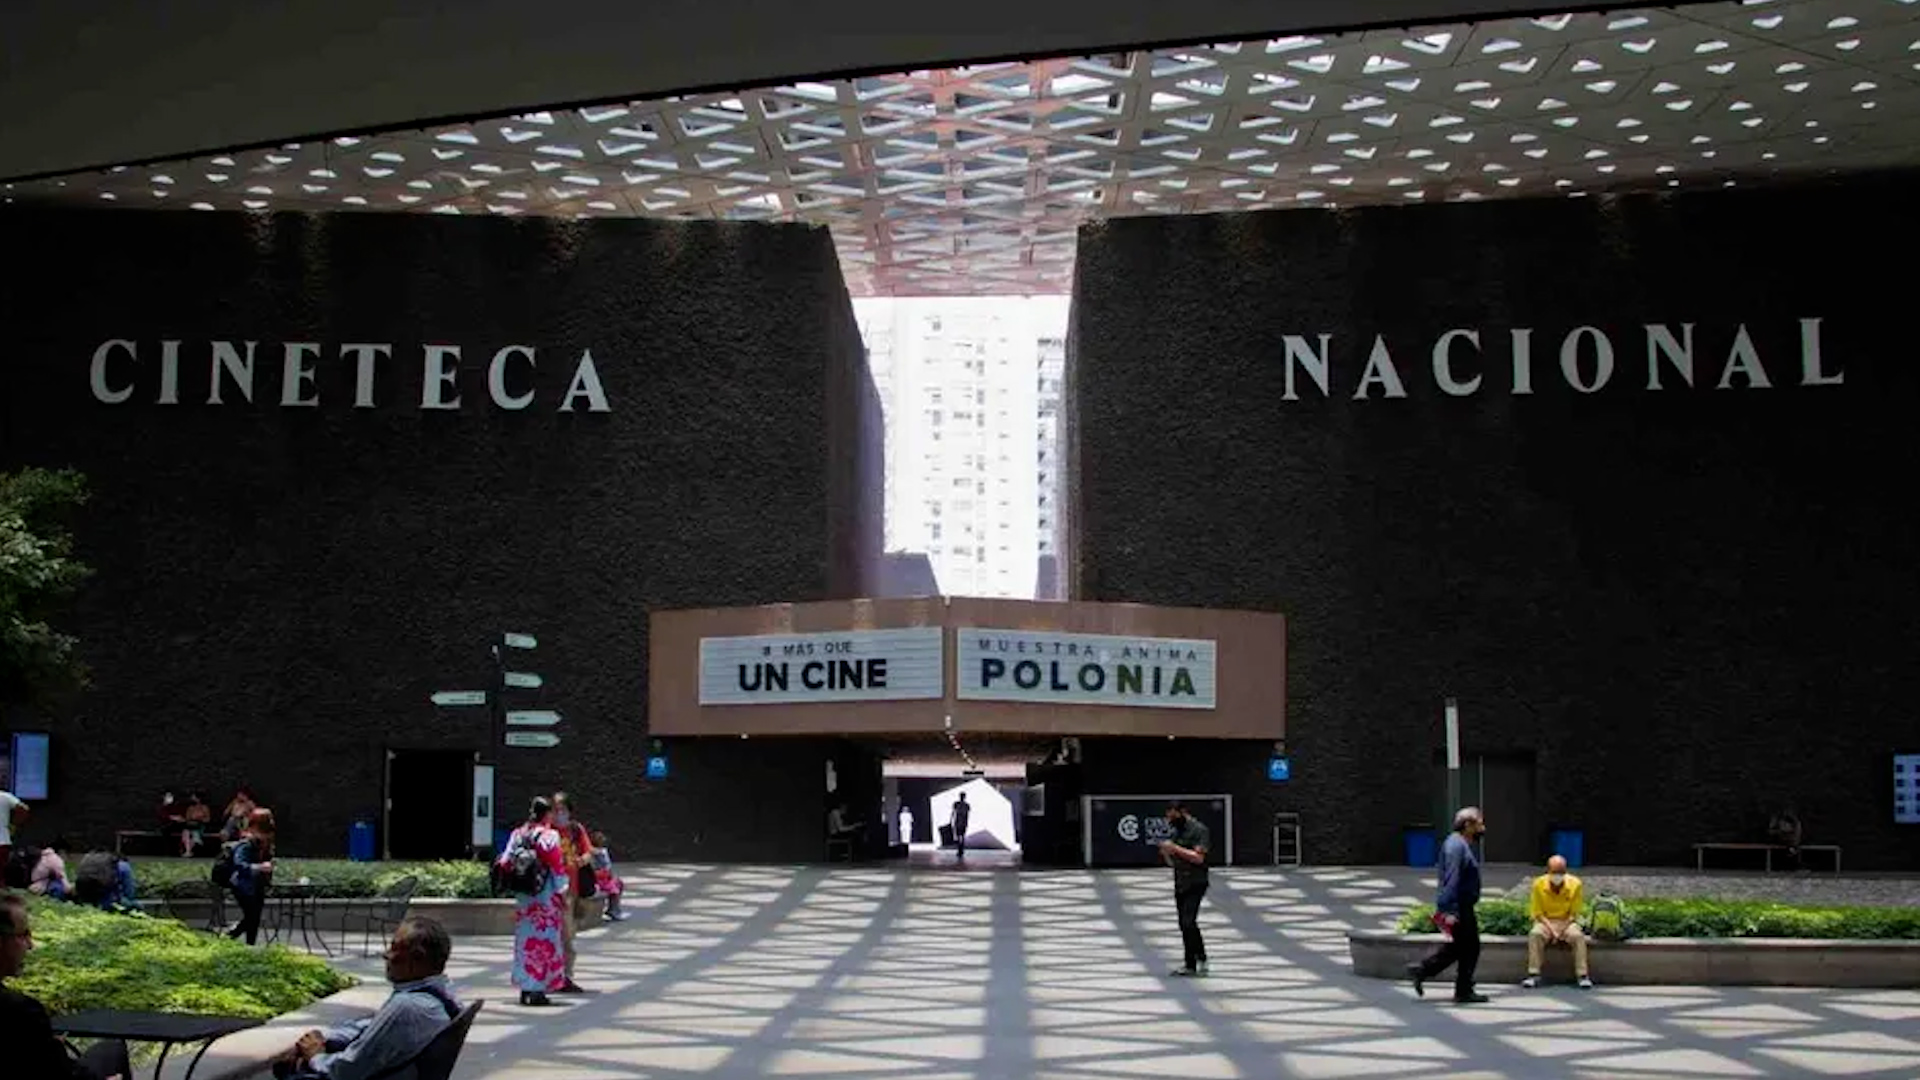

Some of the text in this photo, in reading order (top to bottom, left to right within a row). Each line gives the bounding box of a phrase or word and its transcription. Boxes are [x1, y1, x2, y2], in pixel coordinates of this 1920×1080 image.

[90, 339, 612, 412] CINETECA
[1282, 318, 1845, 401] NACIONAL
[825, 641, 853, 654] QUE
[979, 638, 1197, 661] MUESTRA ANIMA
[738, 658, 887, 691] UN CINE
[981, 657, 1195, 696] POLONIA
